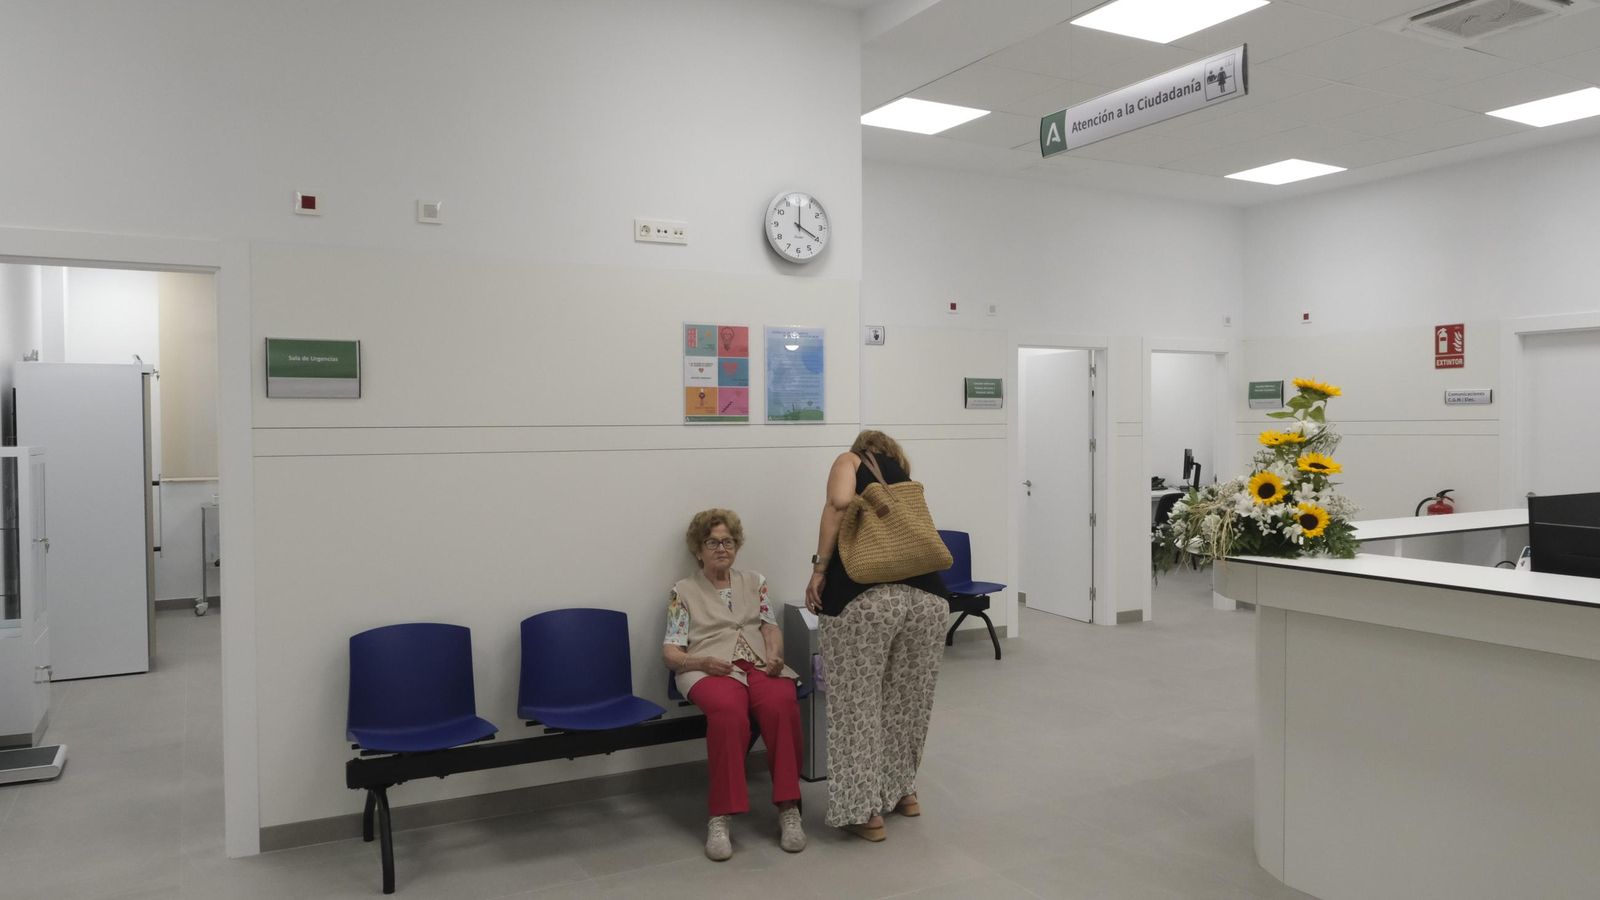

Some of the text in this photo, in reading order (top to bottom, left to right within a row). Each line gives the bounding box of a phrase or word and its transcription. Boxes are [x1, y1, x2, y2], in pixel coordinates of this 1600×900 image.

[1071, 78, 1202, 134] Atención a la Ciudadanía
[310, 355, 339, 363] Urgencias
[1436, 358, 1463, 367] EXTINTOR
